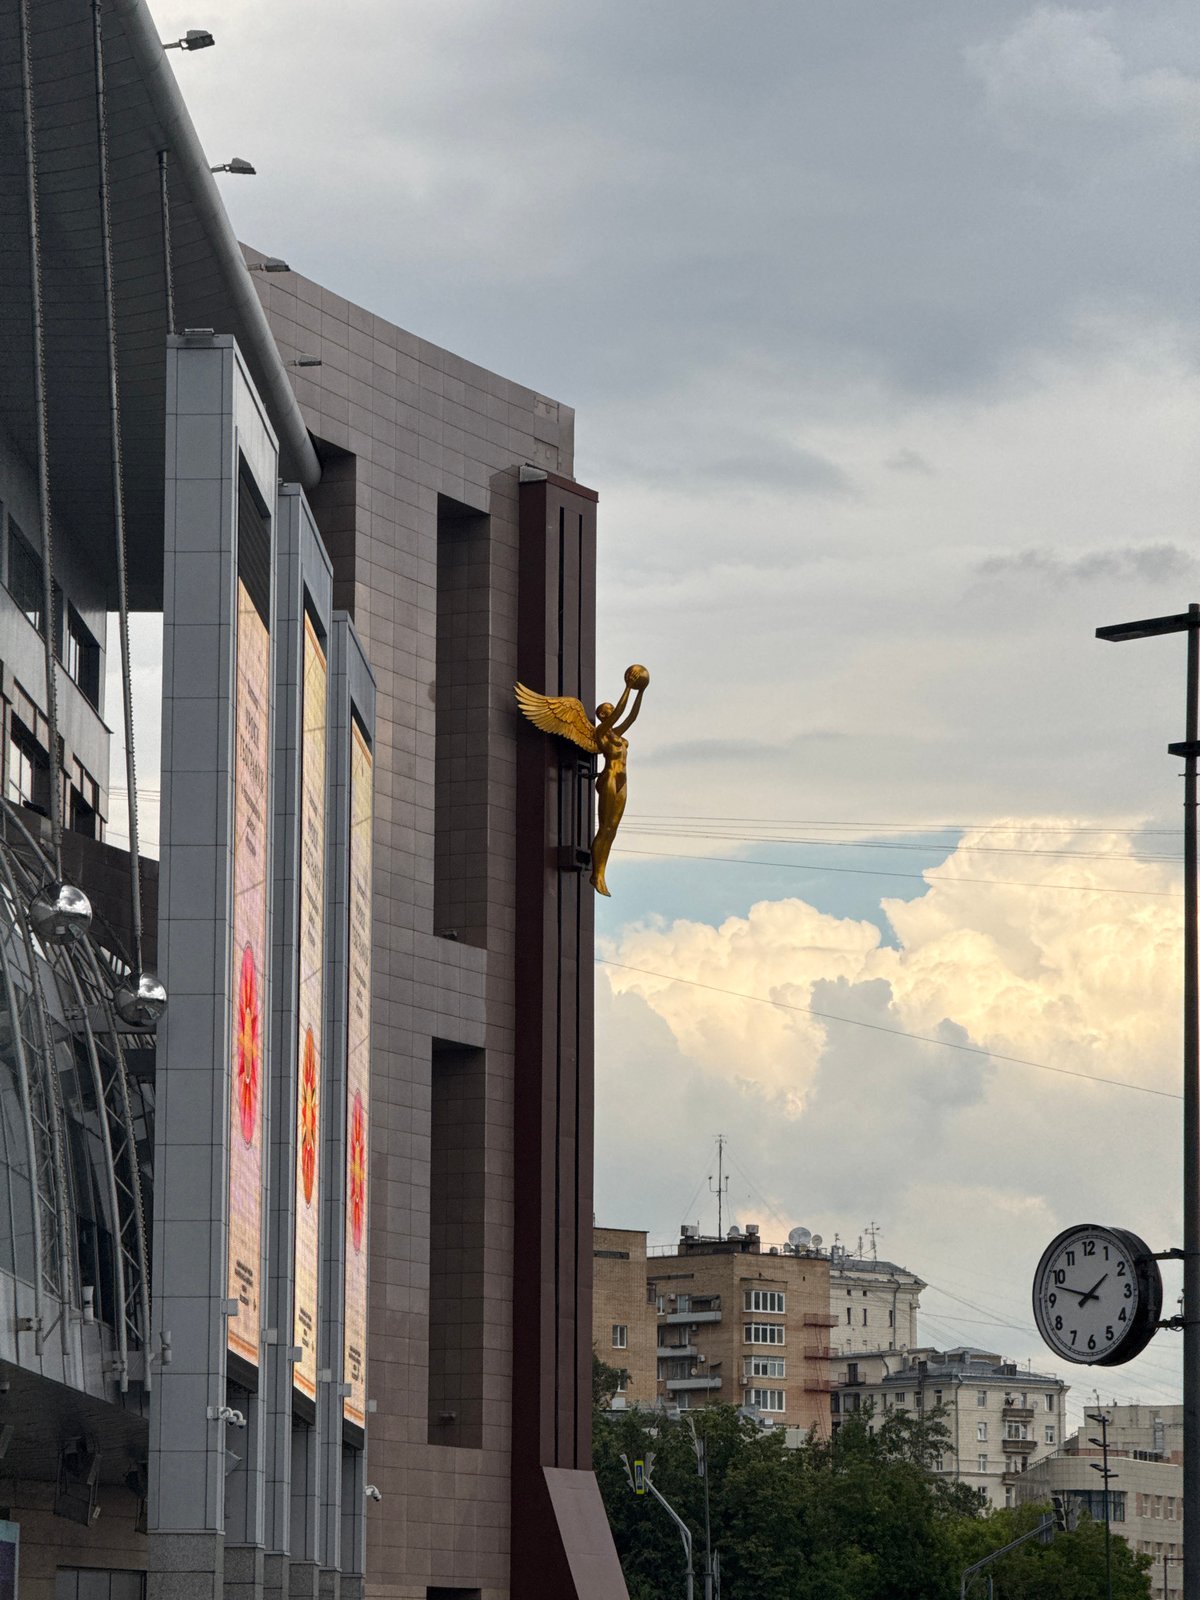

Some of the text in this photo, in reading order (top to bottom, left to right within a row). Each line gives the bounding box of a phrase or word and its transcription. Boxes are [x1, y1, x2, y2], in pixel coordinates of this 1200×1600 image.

[1082, 1240, 1095, 1256] 12
[1103, 1246, 1109, 1261] 1
[1065, 1251, 1075, 1266] 11
[1053, 1269, 1066, 1284] 10
[1117, 1261, 1126, 1277] 2
[1124, 1283, 1132, 1299] 3
[1048, 1293, 1057, 1308] 9
[1118, 1307, 1127, 1322] 4
[1055, 1315, 1063, 1331] 8
[1070, 1330, 1077, 1346] 7
[1105, 1325, 1114, 1341] 5
[1087, 1334, 1096, 1350] 6
